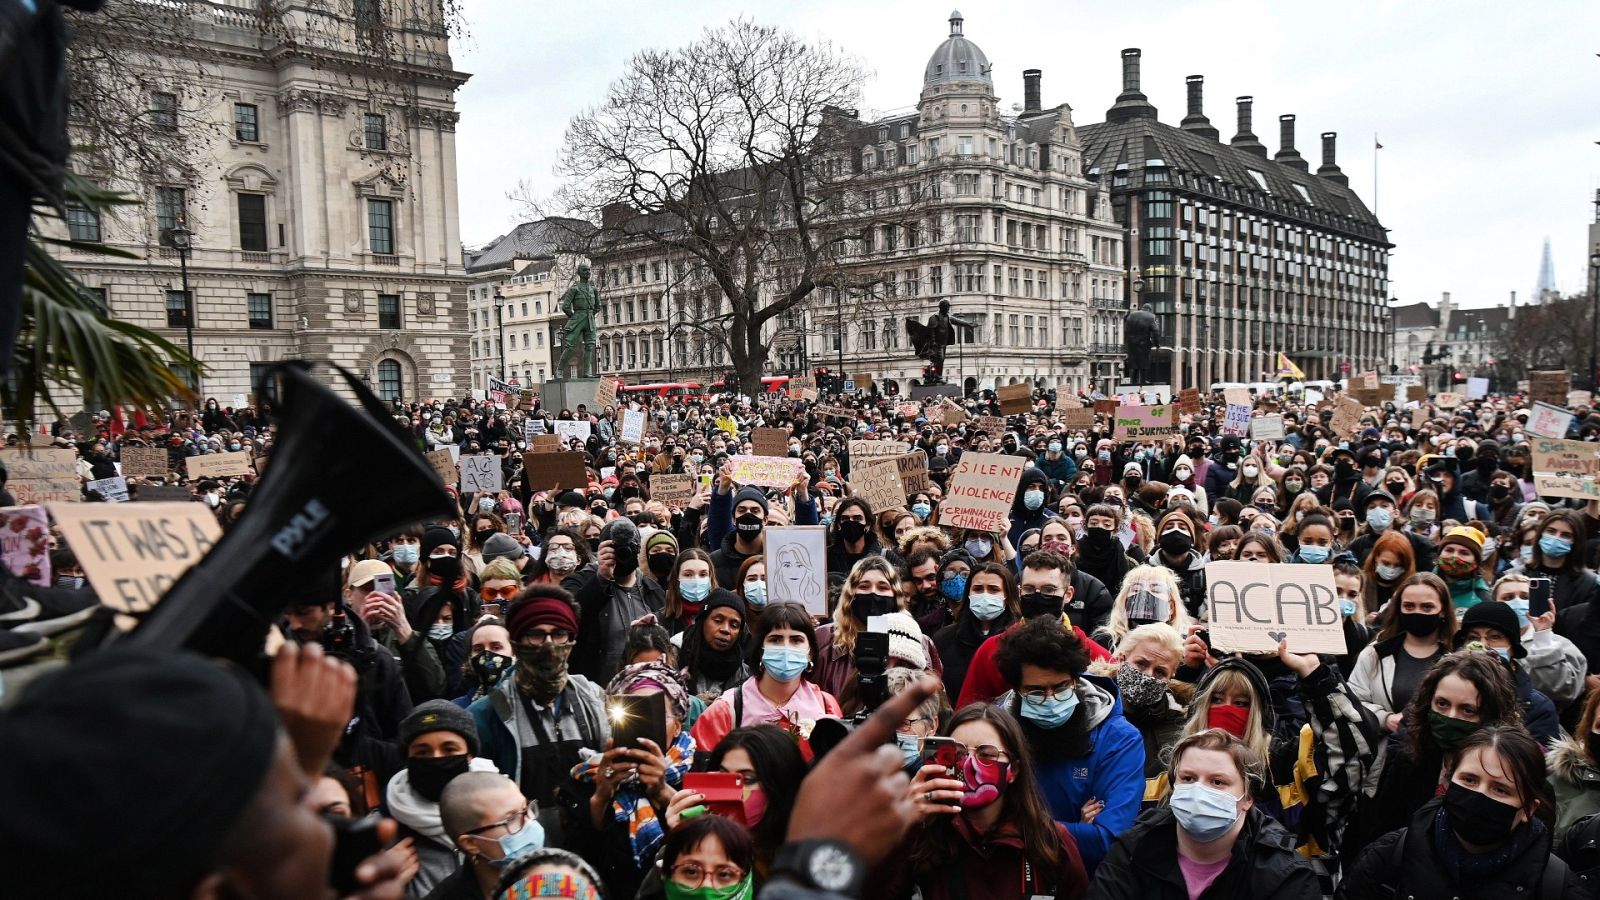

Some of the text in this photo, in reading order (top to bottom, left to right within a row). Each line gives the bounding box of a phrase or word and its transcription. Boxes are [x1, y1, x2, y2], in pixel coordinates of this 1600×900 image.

[1151, 408, 1165, 417] OF
[1228, 404, 1247, 413] THE
[1117, 418, 1142, 427] POWER
[1227, 412, 1250, 422] ISSUE
[1126, 427, 1137, 436] NO
[1223, 428, 1246, 437] MEN
[853, 443, 905, 458] EDUCATE
[960, 461, 1020, 479] SILENT
[16, 492, 71, 502] RIGHTS
[953, 485, 1014, 504] VIOLENCE
[945, 507, 1004, 520] CRIMINALISE
[951, 515, 995, 531] CHANGE
[80, 518, 213, 561] IT WAS A
[1209, 580, 1338, 625] ACAB
